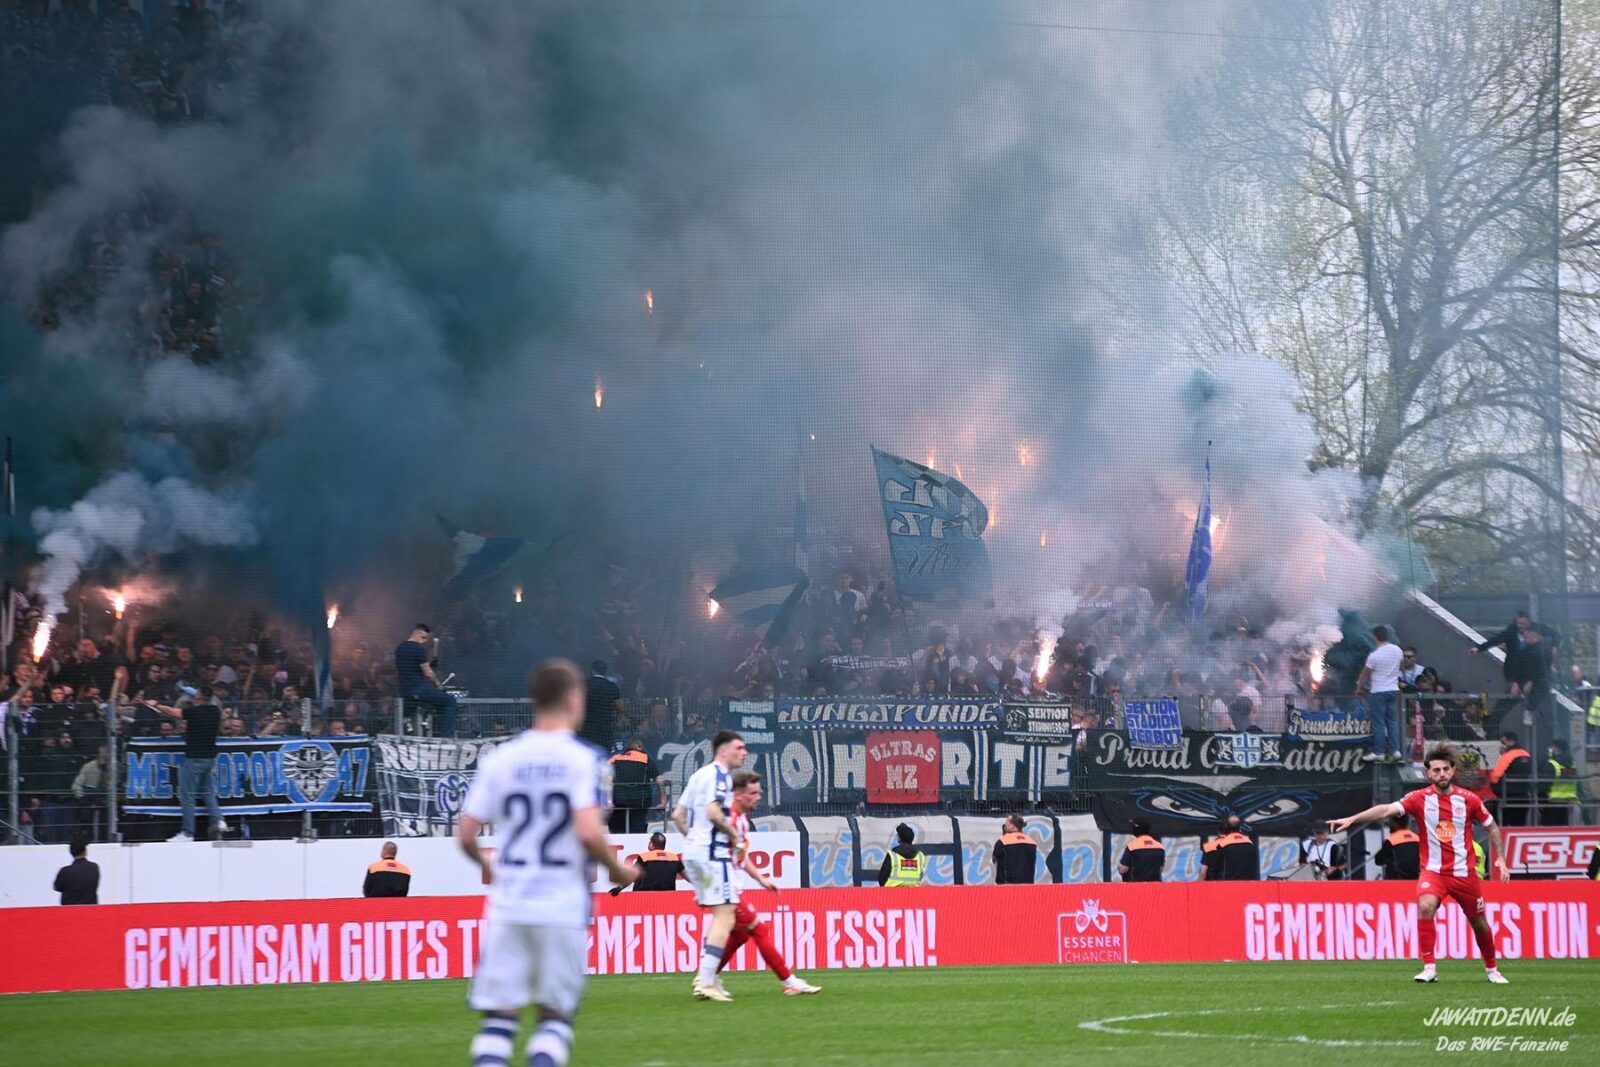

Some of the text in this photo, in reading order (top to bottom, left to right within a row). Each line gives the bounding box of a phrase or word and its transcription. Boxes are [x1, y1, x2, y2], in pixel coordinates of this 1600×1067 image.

[1026, 707, 1069, 720] SEKTION
[1125, 699, 1178, 715] SEKTION
[1127, 713, 1181, 729] STADION
[868, 739, 937, 763] ULTRAS
[1096, 732, 1192, 770] Proud
[337, 747, 370, 797] 47
[886, 764, 918, 790] MZ
[502, 791, 572, 867] 22
[826, 907, 938, 969] ESSEN!
[1064, 935, 1121, 949] ESSENER
[1244, 902, 1418, 961] GEMEINSAM
[1529, 901, 1589, 960] TUN
[124, 922, 330, 988] GEMEINSAM
[339, 919, 448, 982] GUTES
[1064, 950, 1122, 963] CHANCEN
